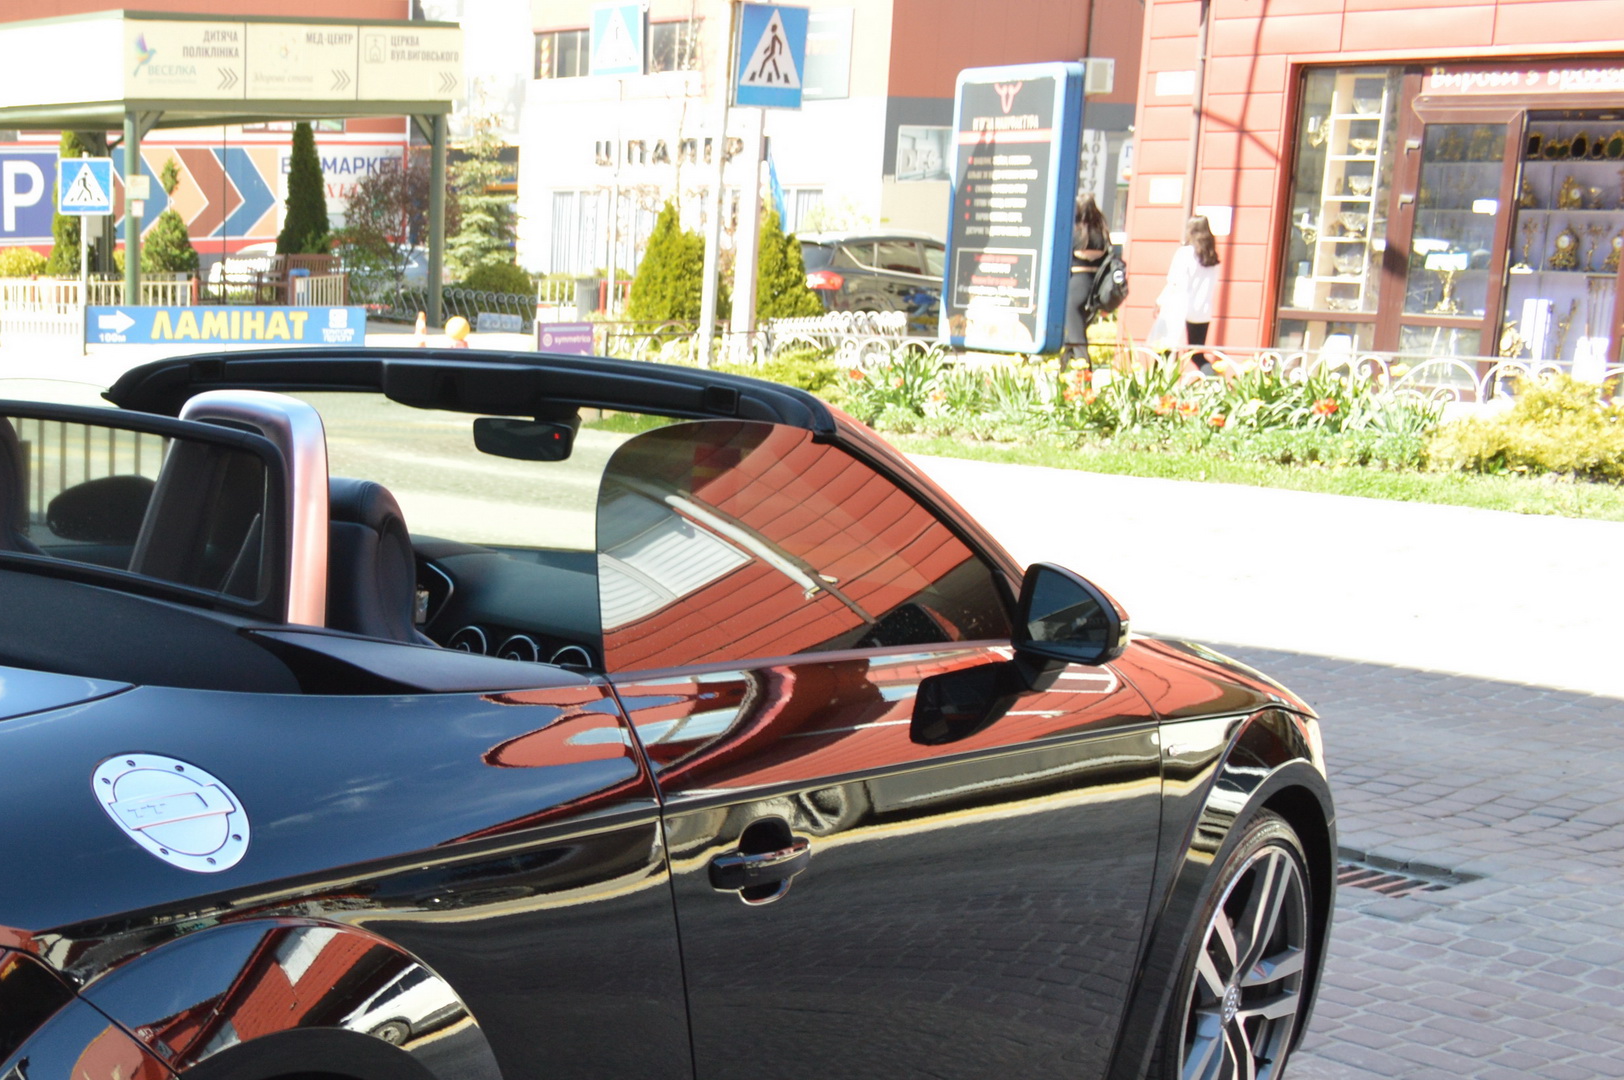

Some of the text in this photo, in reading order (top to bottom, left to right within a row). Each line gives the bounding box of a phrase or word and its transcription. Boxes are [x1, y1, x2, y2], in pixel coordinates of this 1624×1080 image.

[203, 30, 239, 43] ДИТЯЧА
[306, 32, 354, 46] МЕД-ЦЕНТР
[390, 35, 420, 47] ЦЕРКВА
[182, 46, 240, 59] ПОЛІКЛІНІКА
[148, 65, 197, 77] ВЕСЕЛКА
[281, 156, 404, 175] БМАРКЕТ
[2, 161, 45, 232] P
[150, 310, 309, 340] ЛАМІНАТ
